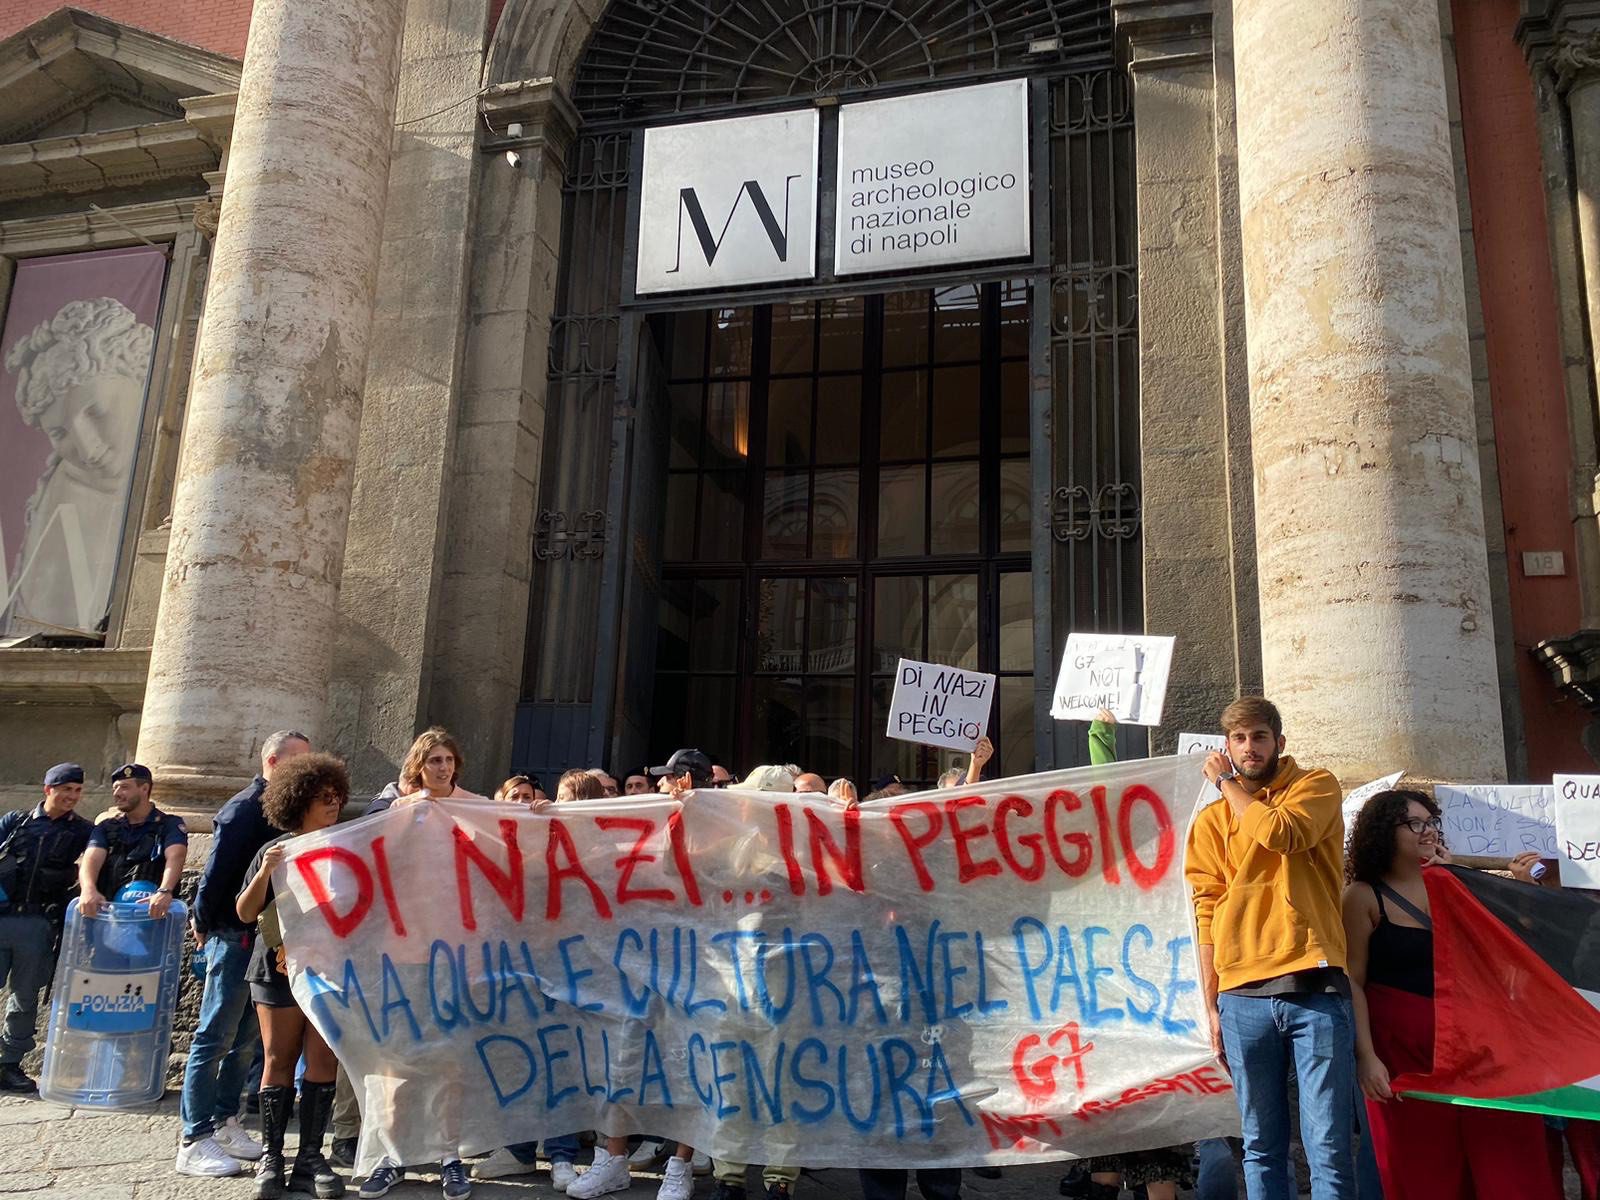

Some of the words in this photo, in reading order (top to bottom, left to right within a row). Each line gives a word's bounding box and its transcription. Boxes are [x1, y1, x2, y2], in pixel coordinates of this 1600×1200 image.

[852, 159, 935, 184] museo
[851, 170, 1016, 208] archeologico
[850, 199, 971, 231] nazionale
[850, 231, 873, 255] di
[881, 224, 959, 253] napoli
[1074, 655, 1095, 670] G7
[1089, 666, 1125, 687] NOT
[1447, 791, 1474, 809] LA
[1487, 790, 1552, 814] CULTU
[1562, 780, 1600, 803] QUA
[1447, 817, 1486, 833] NON
[1516, 816, 1556, 830] SOL
[1467, 835, 1507, 854] DEI
[1520, 833, 1558, 854] RIC
[295, 835, 407, 938] DI
[776, 802, 866, 897] IN
[889, 783, 1177, 893] PEGGIO
[305, 952, 423, 1043] MA
[428, 938, 606, 1033] QUALE
[613, 926, 888, 1028] CULTURA
[895, 919, 1009, 1025] NEL
[1011, 916, 1200, 1036] PAESE
[81, 995, 146, 1013] POLIZIA
[1012, 1021, 1095, 1100] G7
[475, 1022, 674, 1109] DELLA
[687, 1032, 976, 1140] CENSURA
